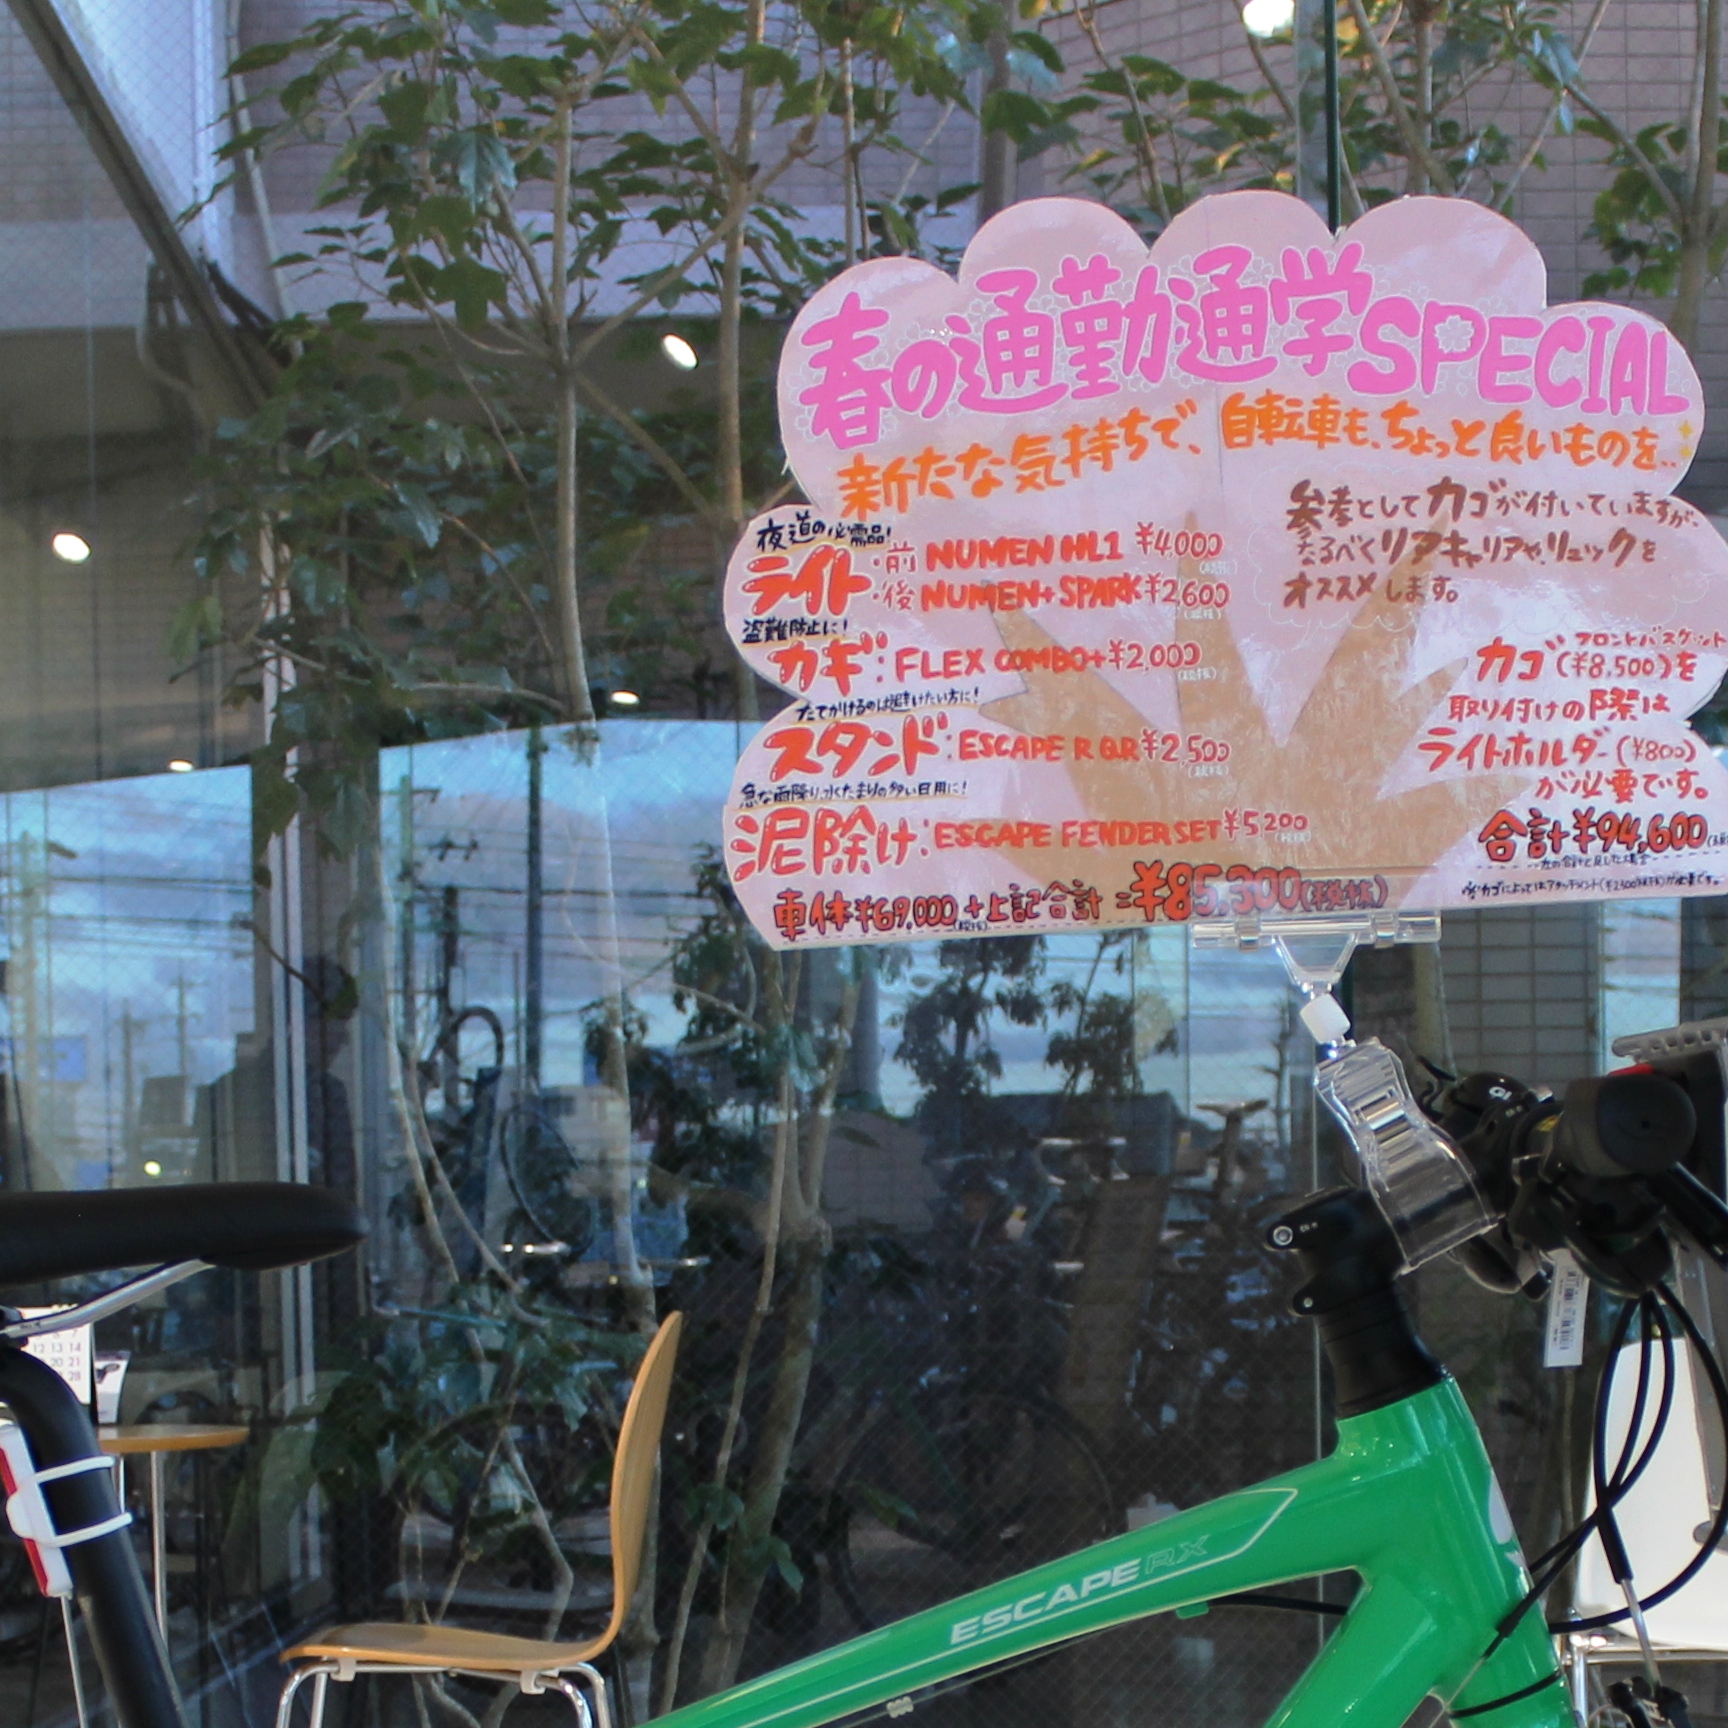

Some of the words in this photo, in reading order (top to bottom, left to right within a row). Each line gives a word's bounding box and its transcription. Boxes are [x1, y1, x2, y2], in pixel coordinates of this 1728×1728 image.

[757, 510, 892, 552] 夜道の必需品!
[926, 533, 1054, 571] NUMEN
[1061, 531, 1124, 565] HL1
[1136, 521, 1224, 559] ¥4,000
[742, 544, 872, 616] ライト
[922, 579, 1056, 613] NUMEN+
[1060, 573, 1142, 609] SPARK
[1283, 572, 1459, 608] オススメします。
[742, 620, 848, 644] 盗難防止に!
[1575, 626, 1728, 647] フロントバスケット
[895, 647, 986, 683] FLEX
[1448, 688, 1671, 723] 取り付けの際は
[959, 729, 1066, 763] ESCAPE
[1074, 735, 1095, 762] R
[1535, 768, 1710, 803] が必要です。
[934, 820, 1052, 849] ESCAPE
[1061, 819, 1174, 847] FENDER
[1174, 818, 1222, 844] SET
[51, 1343, 63, 1353] 13
[69, 1343, 81, 1353] 14
[51, 1357, 63, 1367] 20
[950, 1558, 1142, 1645] ESCAPE
[1145, 1535, 1209, 1575] RX
